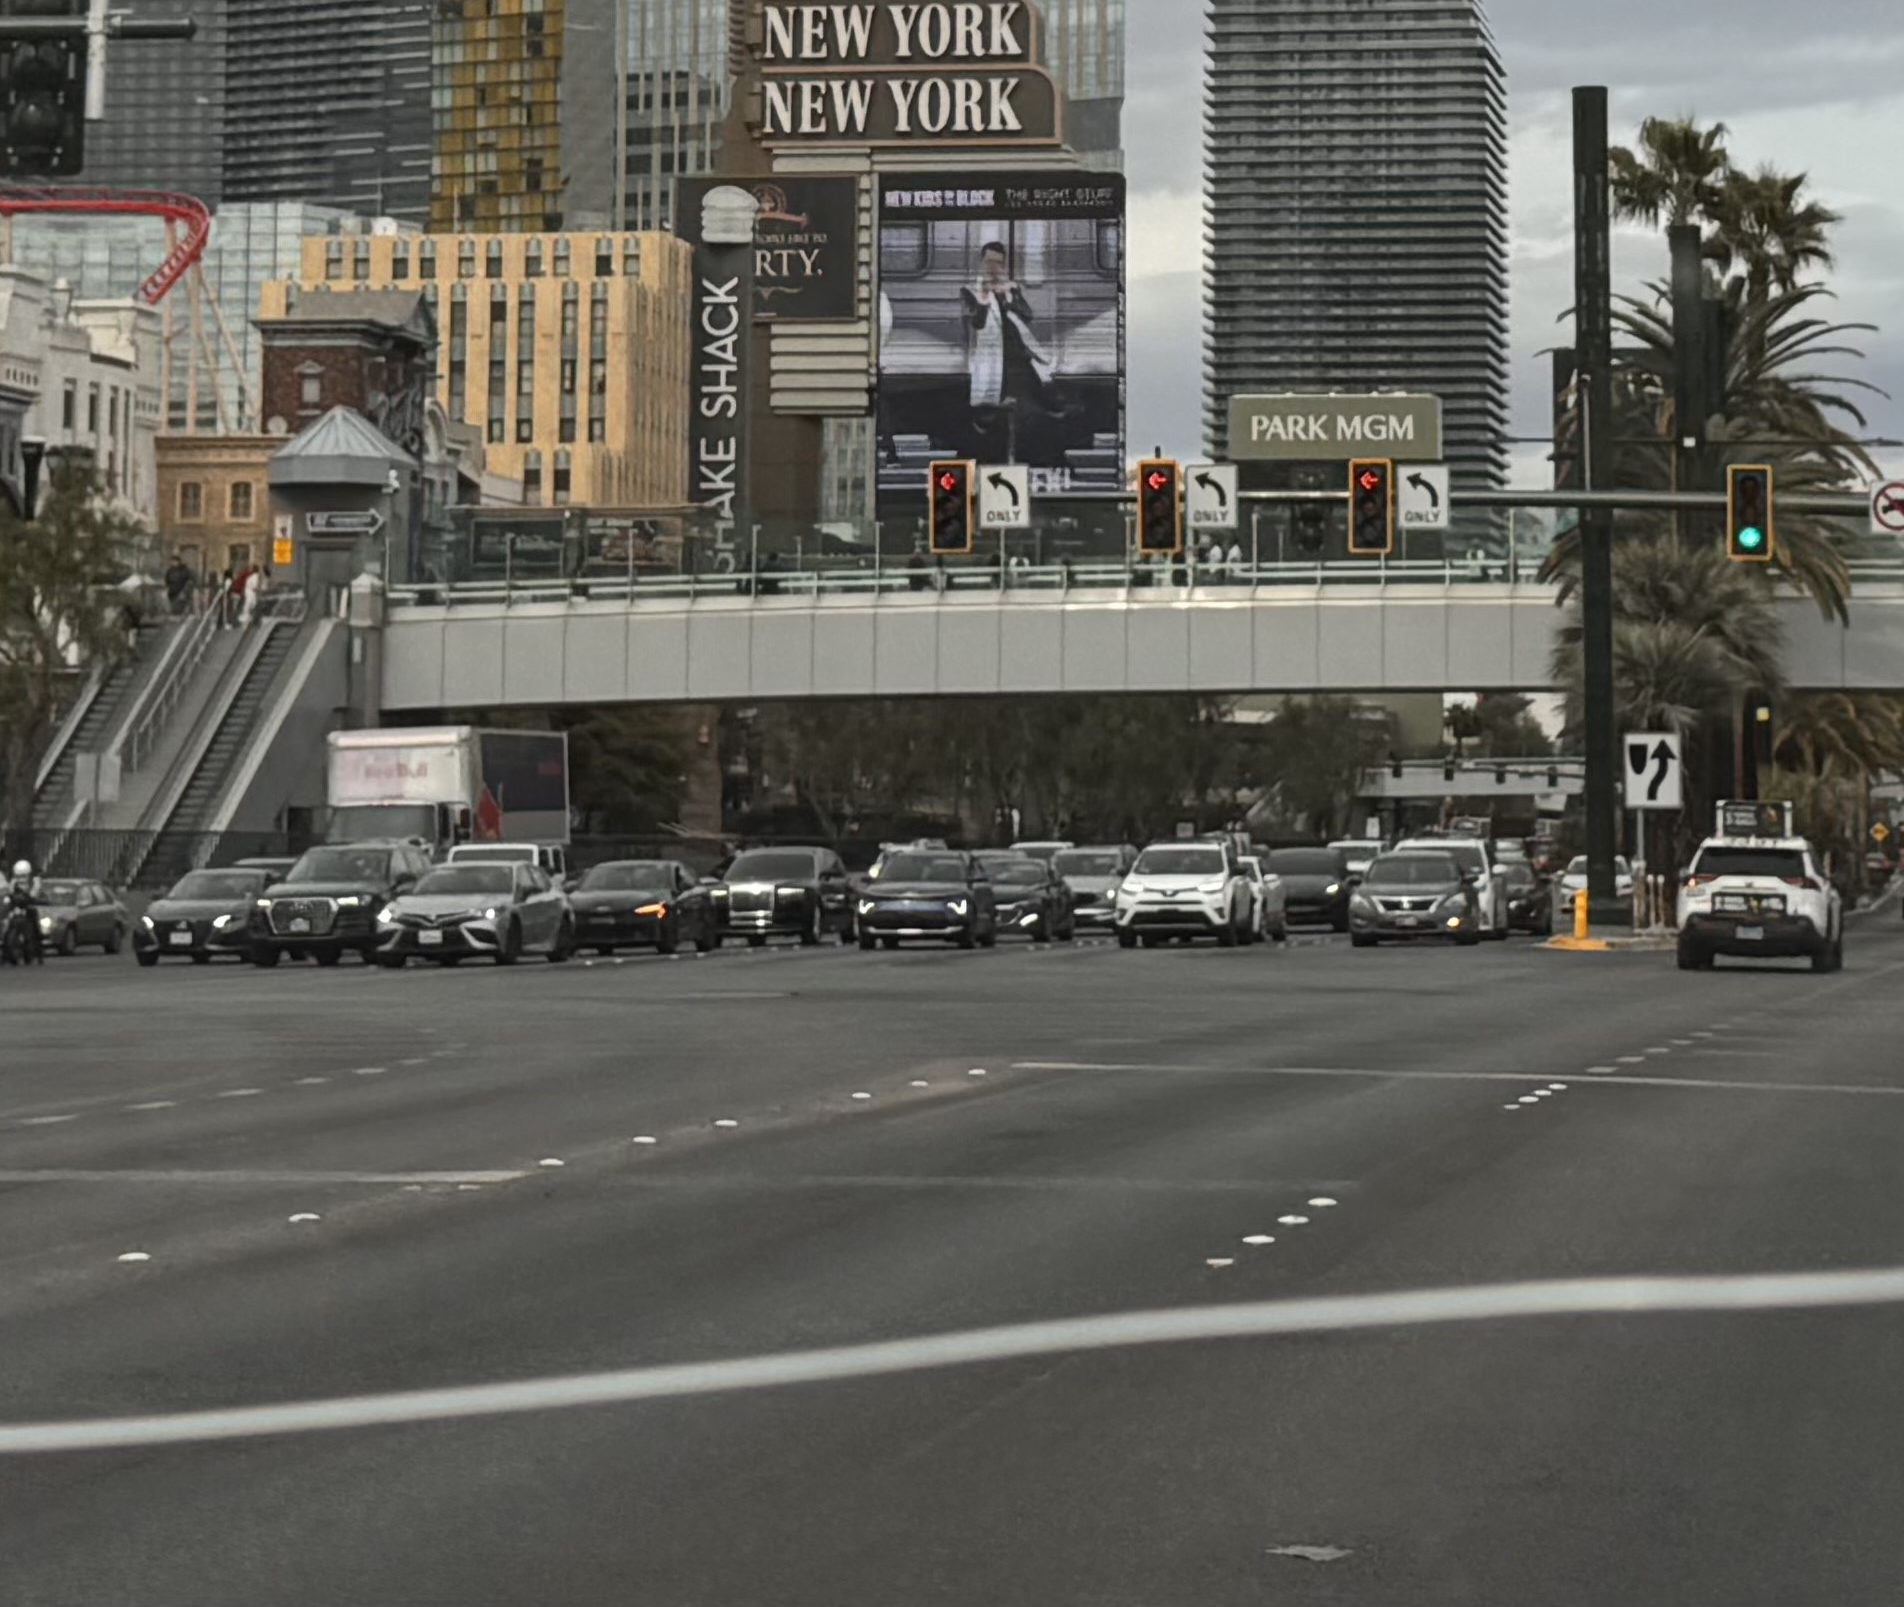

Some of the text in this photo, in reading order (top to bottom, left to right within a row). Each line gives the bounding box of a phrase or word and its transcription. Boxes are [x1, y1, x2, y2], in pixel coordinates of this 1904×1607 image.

[762, 1, 1023, 60] NEW YORK
[761, 77, 1023, 135] NEW YORK
[700, 276, 739, 418] SHACK
[1251, 413, 1415, 441] PARK MGM
[986, 509, 1021, 523] ONLY
[1193, 509, 1229, 523] ONLY
[1404, 509, 1442, 523] ONLY
